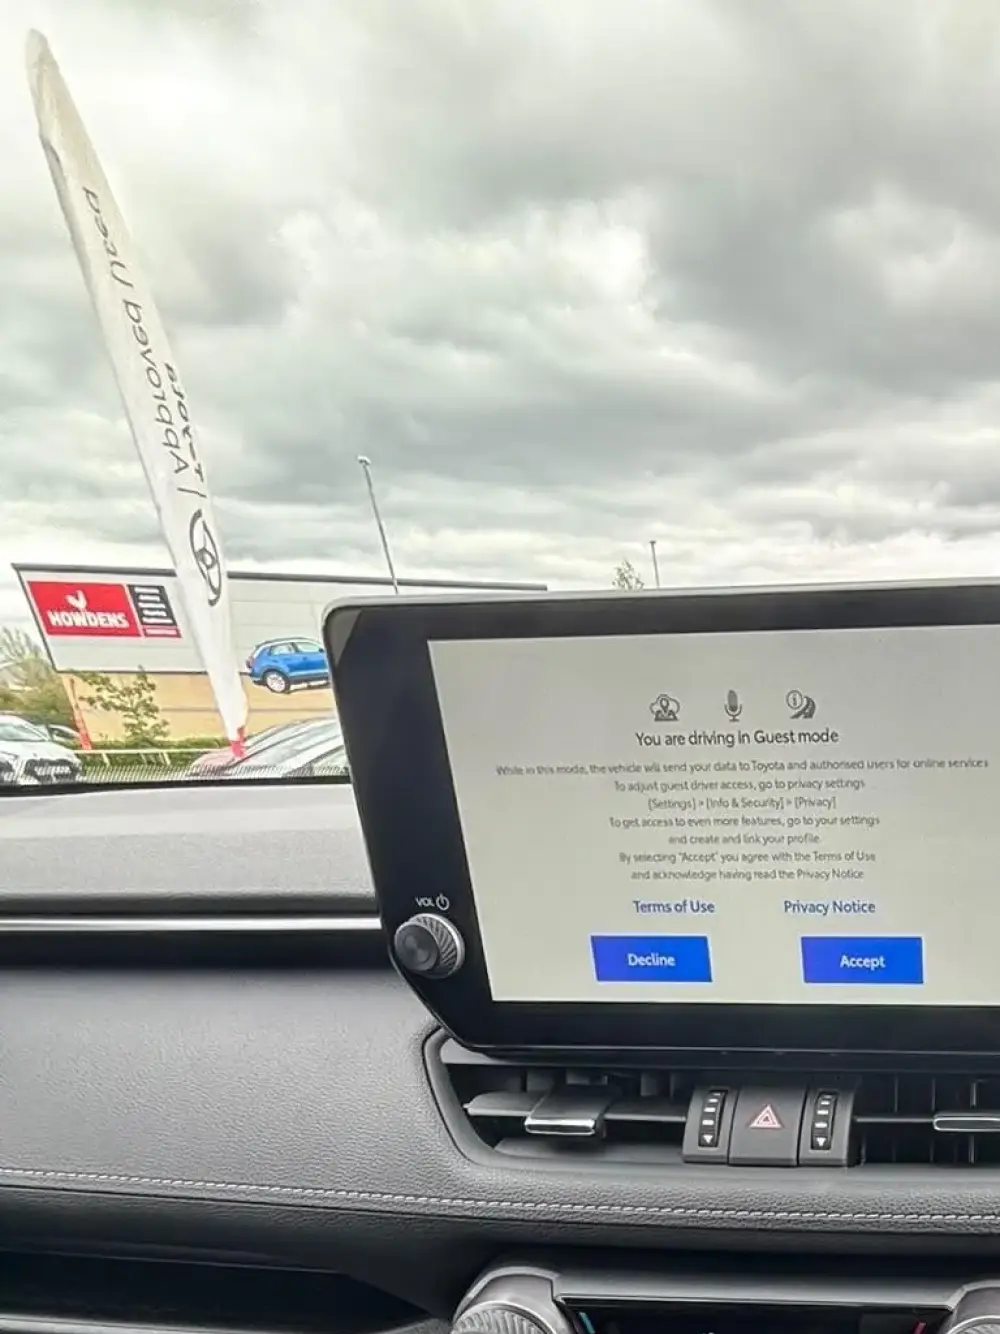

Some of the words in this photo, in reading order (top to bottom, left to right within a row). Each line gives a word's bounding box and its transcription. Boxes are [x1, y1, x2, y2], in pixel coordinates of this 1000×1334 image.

[46, 610, 130, 628] HOWDENS
[636, 732, 660, 746] You
[665, 734, 686, 746] are
[688, 731, 734, 748] driving
[738, 731, 750, 744] in
[754, 730, 794, 743] Guest
[798, 728, 839, 743] mode
[590, 763, 606, 774] the
[608, 762, 642, 773] vehicle
[644, 762, 660, 772] will
[662, 761, 686, 772] send
[690, 762, 711, 774] your
[714, 760, 736, 772] data
[738, 761, 750, 771] to
[751, 760, 784, 773] Toyota
[787, 760, 807, 770] and
[810, 758, 864, 770] authorised
[867, 760, 894, 770] users
[896, 758, 911, 769] for
[914, 758, 945, 768] online
[948, 758, 988, 768] services
[614, 781, 625, 792] To
[628, 780, 658, 793] adjust
[660, 780, 688, 793] guest
[690, 780, 718, 790] driver
[758, 780, 772, 792] go
[775, 778, 785, 789] to
[788, 778, 822, 792] privacy
[825, 778, 864, 790] settings
[732, 799, 738, 808] &
[609, 816, 621, 828] To
[622, 817, 638, 829] get
[642, 818, 673, 828] access
[675, 816, 686, 827] to
[688, 818, 711, 827] even
[713, 818, 739, 826] more
[787, 816, 801, 828] go
[803, 816, 814, 826] to
[815, 816, 838, 828] your
[840, 814, 880, 827] settings
[668, 834, 687, 844] and
[690, 834, 720, 844] create
[722, 834, 741, 844] and
[742, 834, 760, 844] link
[760, 836, 785, 846] your
[619, 852, 631, 865] By
[633, 852, 676, 864] selecting
[720, 854, 738, 864] you
[741, 852, 769, 864] agree
[772, 851, 792, 862] with
[794, 852, 810, 862] the
[813, 850, 842, 861] Terms
[844, 850, 854, 861] of
[856, 851, 876, 861] Use
[630, 870, 650, 880] and
[652, 870, 716, 882] acknowledge
[719, 869, 752, 882] having
[754, 869, 776, 879] read
[778, 869, 795, 879] the
[797, 868, 830, 882] Privacy
[414, 896, 435, 907] VOL
[633, 900, 671, 913] Terms
[675, 900, 688, 913] of
[690, 900, 715, 913] Use
[784, 900, 829, 916] Privacy
[833, 900, 876, 913] Notice
[628, 953, 676, 967] Decline
[840, 955, 886, 971] Accept
